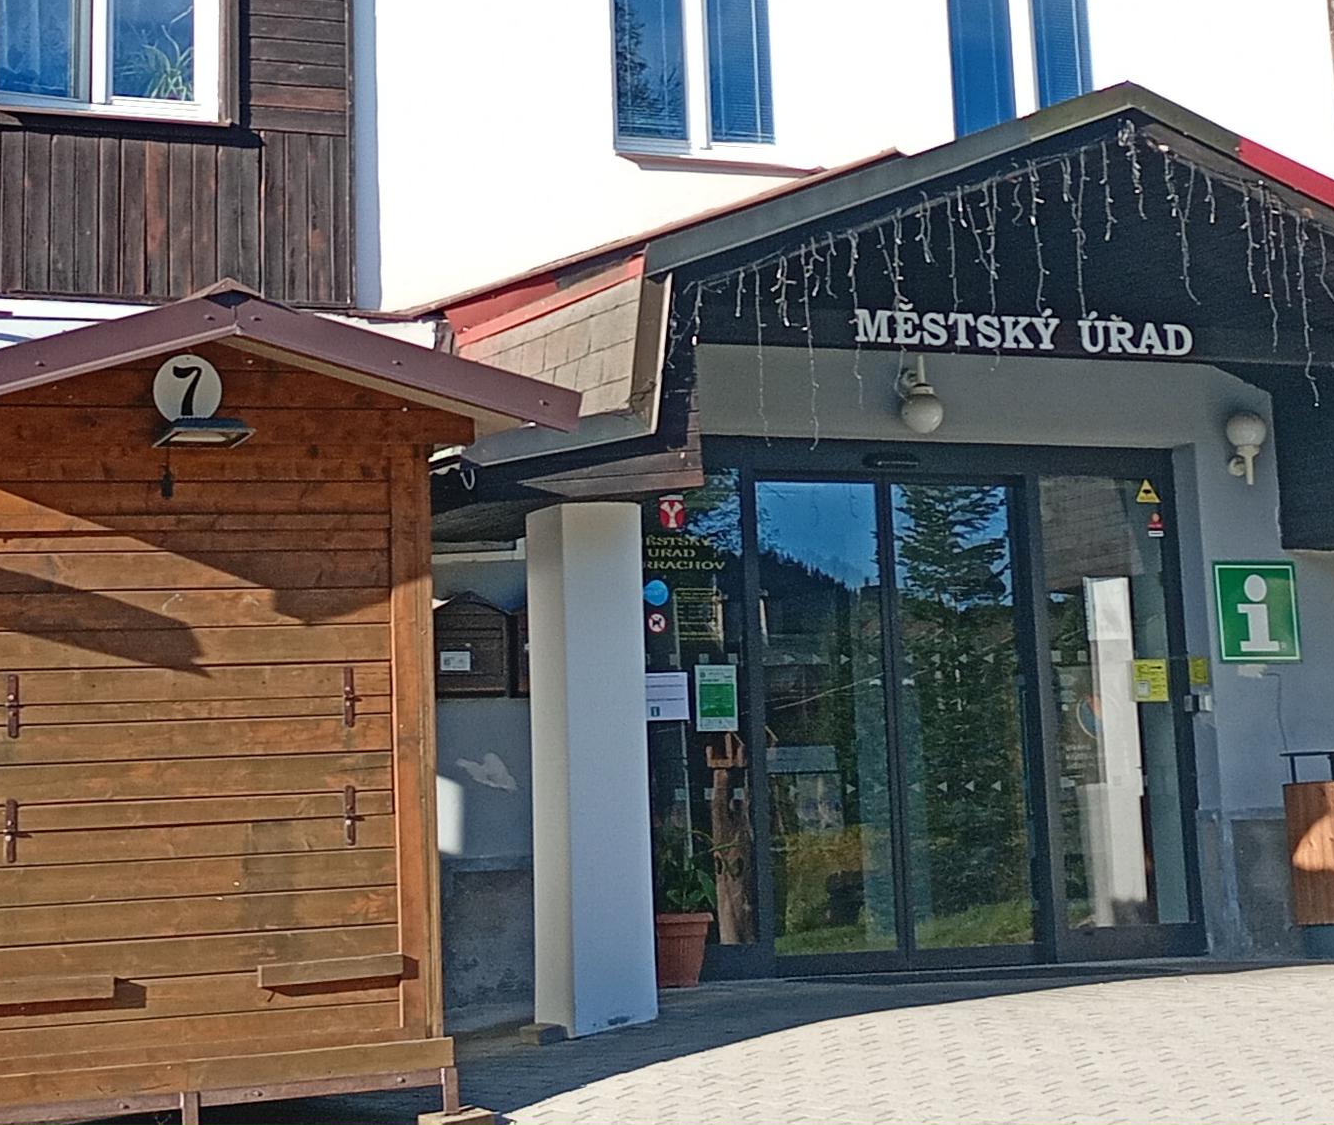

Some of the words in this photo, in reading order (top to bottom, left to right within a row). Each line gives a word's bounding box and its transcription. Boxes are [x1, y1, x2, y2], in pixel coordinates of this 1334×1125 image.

[854, 302, 1060, 350] MĚSTSKÝ
[1078, 310, 1194, 356] ÚŘAD
[173, 366, 202, 416] 7
